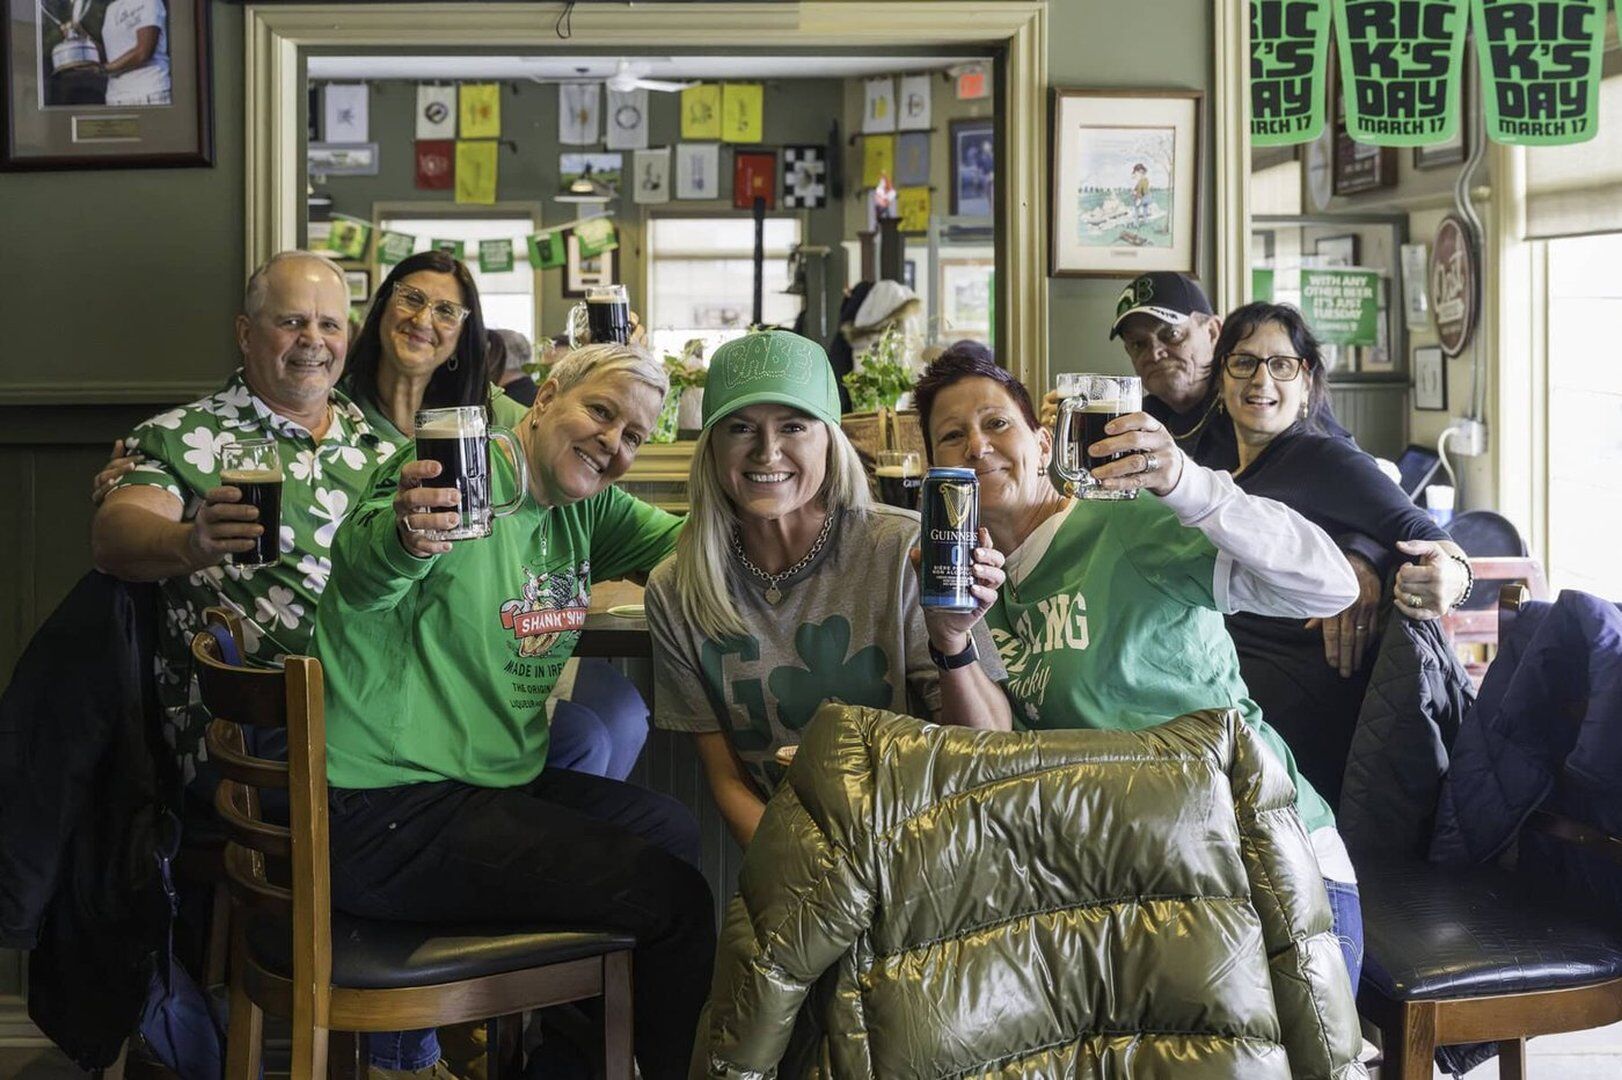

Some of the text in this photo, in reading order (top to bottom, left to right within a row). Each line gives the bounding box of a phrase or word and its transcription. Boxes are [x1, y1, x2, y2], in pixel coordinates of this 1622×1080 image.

[1250, 1, 1318, 39] IC
[1345, 1, 1456, 40] RIC
[1484, 3, 1595, 42] RIC
[1350, 42, 1451, 78] K'S
[1490, 43, 1591, 80] K'S
[1251, 77, 1312, 118] AY
[1355, 79, 1447, 118] DAY
[1495, 80, 1588, 120] DAY
[1251, 115, 1312, 134] RCH 17
[1358, 117, 1446, 135] MARCH 17
[1499, 118, 1587, 136] MARCH 17
[503, 659, 566, 678] MADE IN IRE
